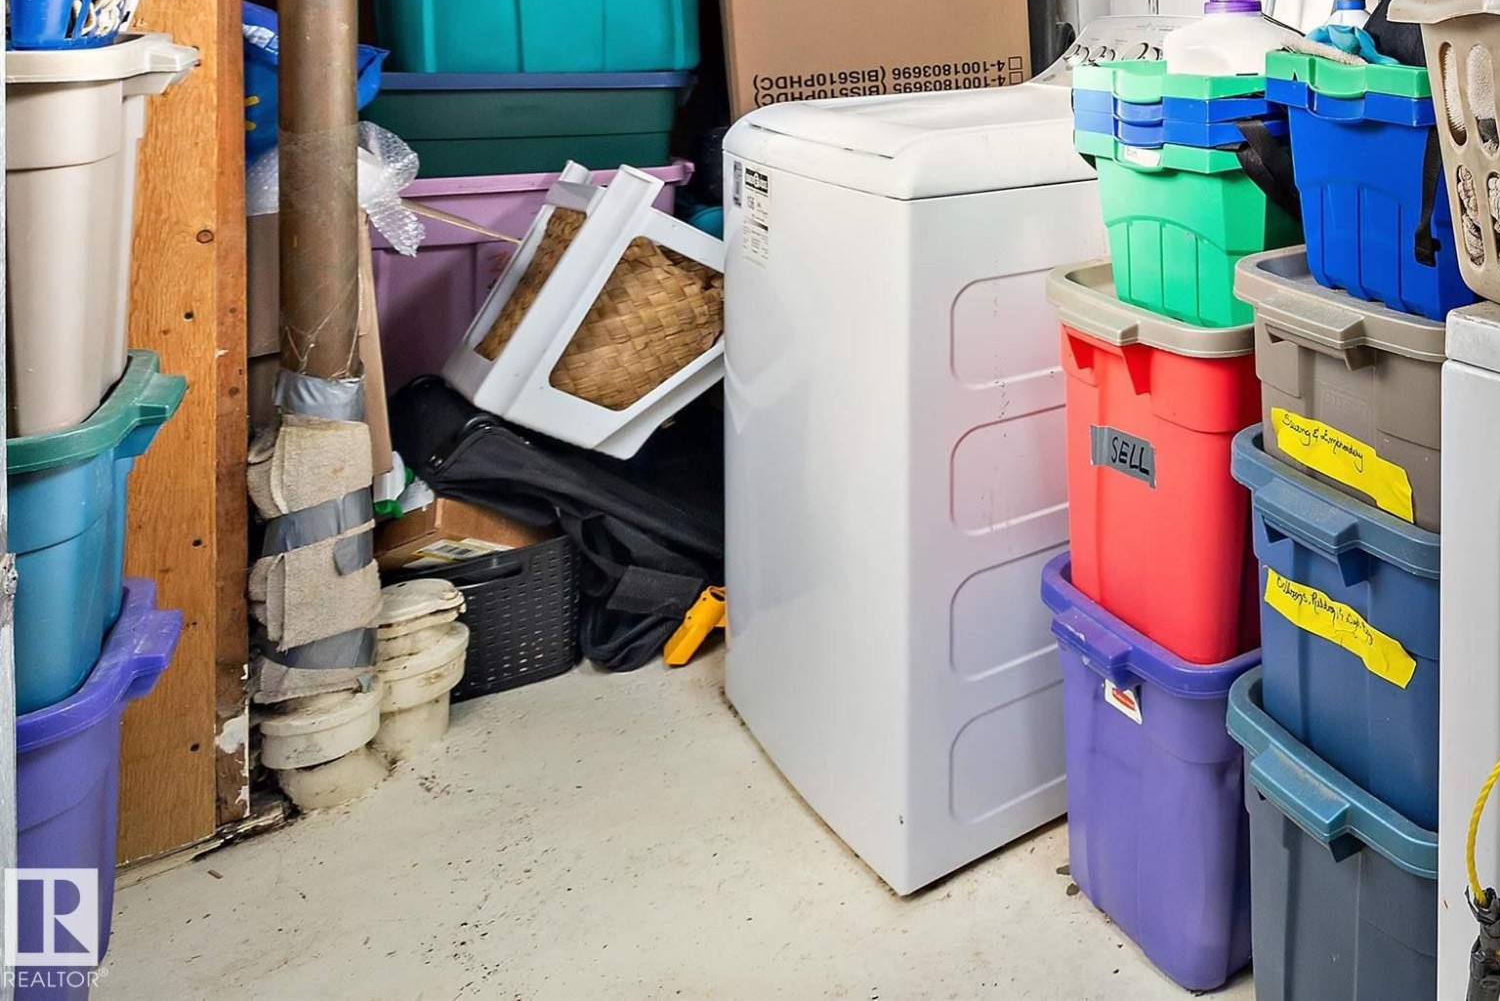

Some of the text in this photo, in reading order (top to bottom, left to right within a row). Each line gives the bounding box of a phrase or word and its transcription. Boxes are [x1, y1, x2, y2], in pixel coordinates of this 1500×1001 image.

[753, 59, 1006, 90] 4-1001803696 (BIS610PHDC)
[1111, 436, 1150, 476] SELL
